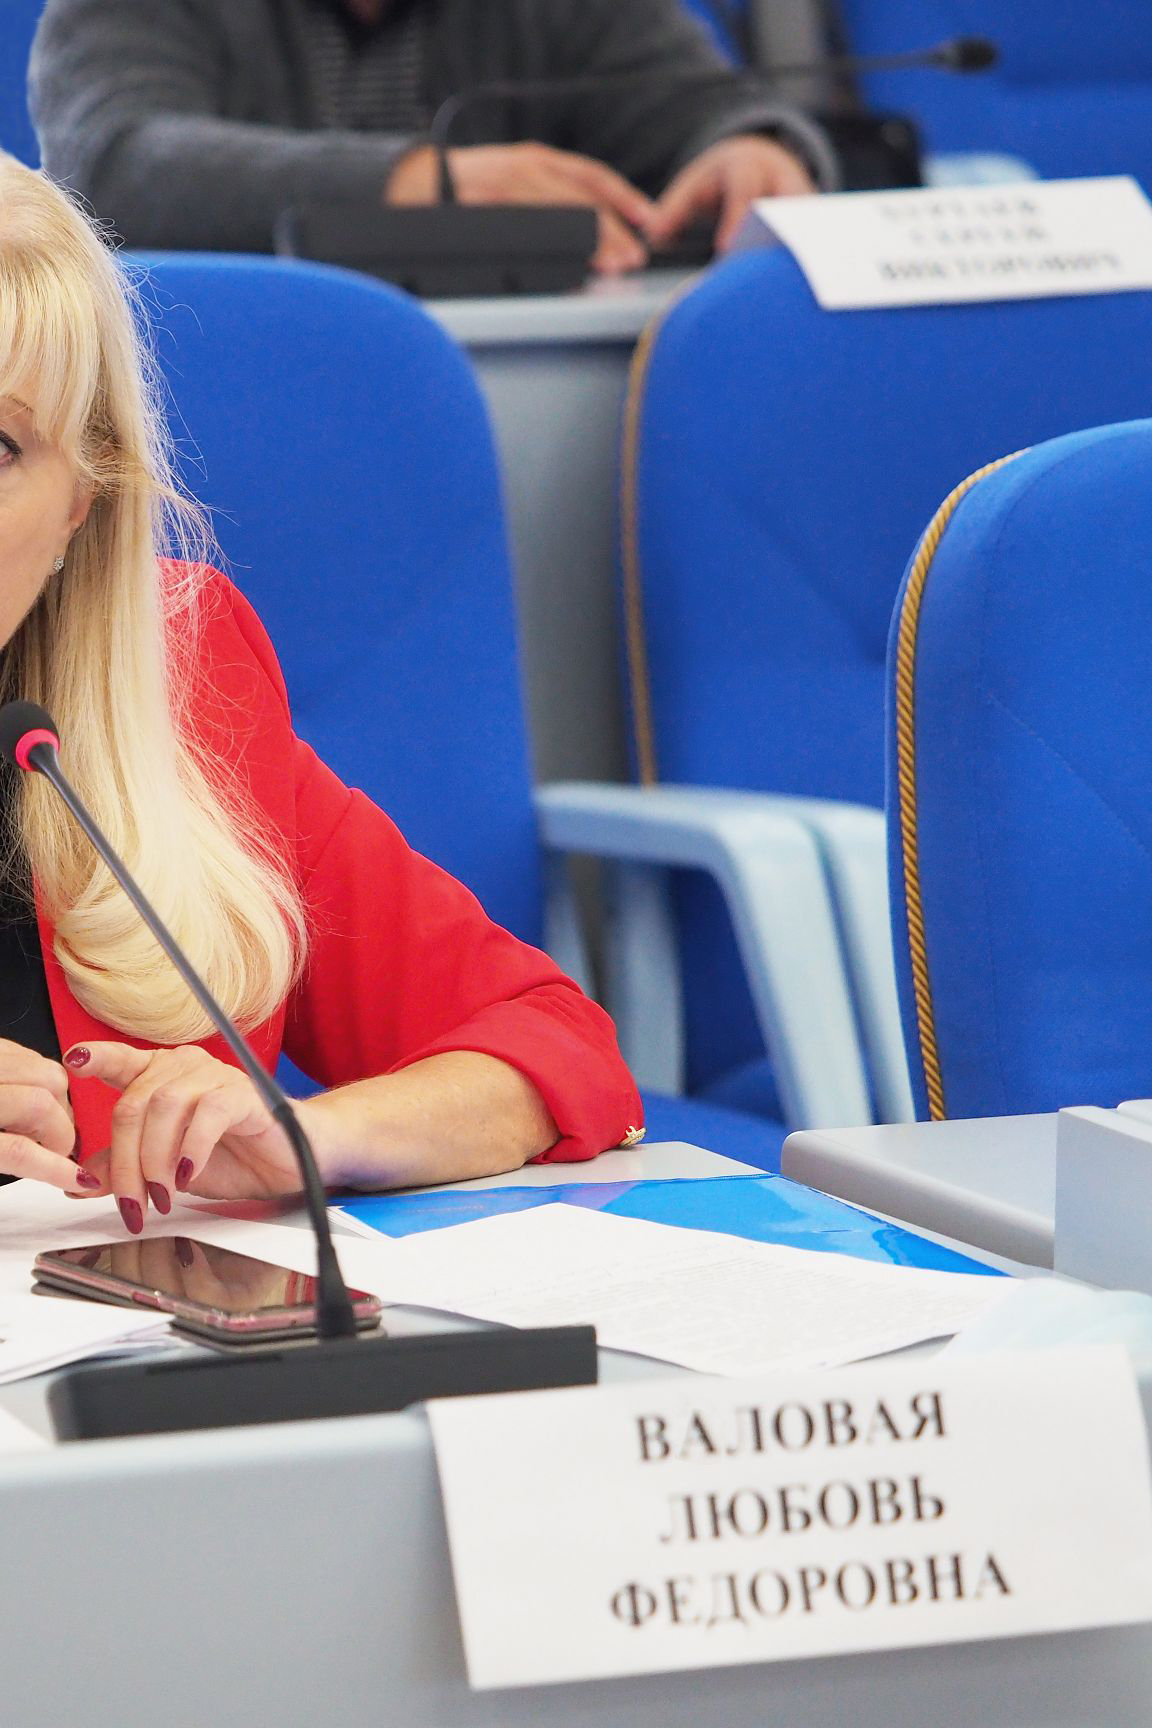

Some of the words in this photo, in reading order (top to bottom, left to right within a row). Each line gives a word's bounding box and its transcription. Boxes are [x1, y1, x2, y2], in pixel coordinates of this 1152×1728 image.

[634, 1391, 948, 1463] ВАЛОВАЯ
[659, 1475, 946, 1545] ЛЮБОВЬ
[609, 1551, 1013, 1631] ФЕДОРОВНА
